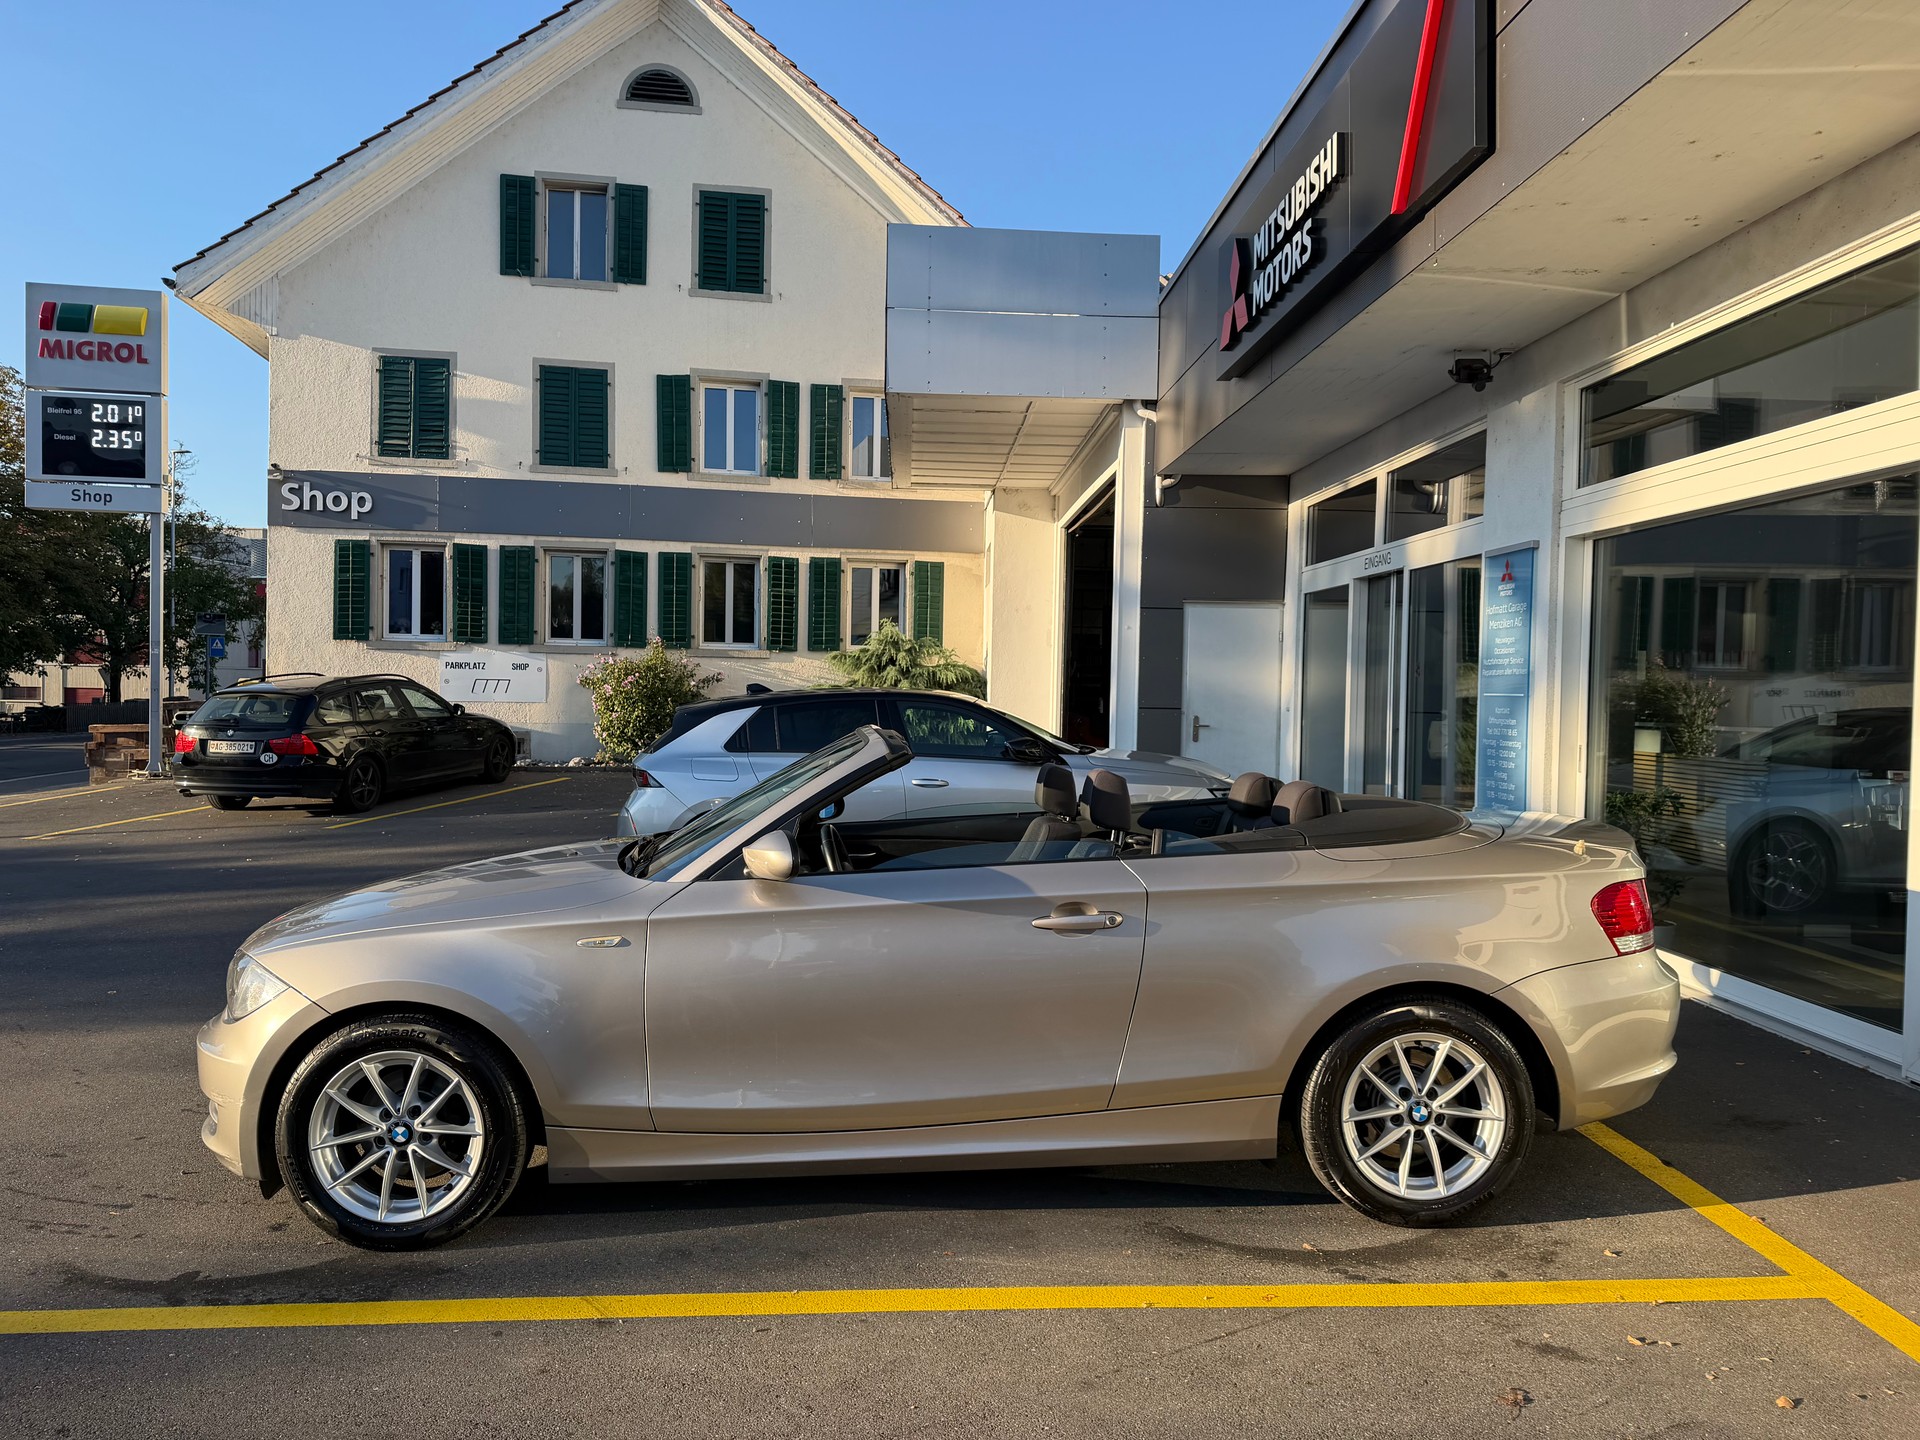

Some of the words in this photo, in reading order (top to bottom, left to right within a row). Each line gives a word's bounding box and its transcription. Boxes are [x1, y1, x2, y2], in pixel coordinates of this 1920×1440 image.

[1253, 131, 1339, 270] MITSUBISHI
[1252, 217, 1313, 317] MOTORS
[38, 338, 149, 364] MIGROL
[47, 406, 73, 415] Bleifrei
[53, 433, 76, 441] Diesel
[71, 489, 113, 506] Shop
[281, 481, 373, 520] Shop
[1364, 551, 1392, 570] EINGANG
[1508, 602, 1528, 614] Garage
[1514, 616, 1523, 627] AG
[445, 661, 486, 670] PARKPLATZ
[511, 663, 530, 671] SHOP
[264, 754, 274, 763] CH
